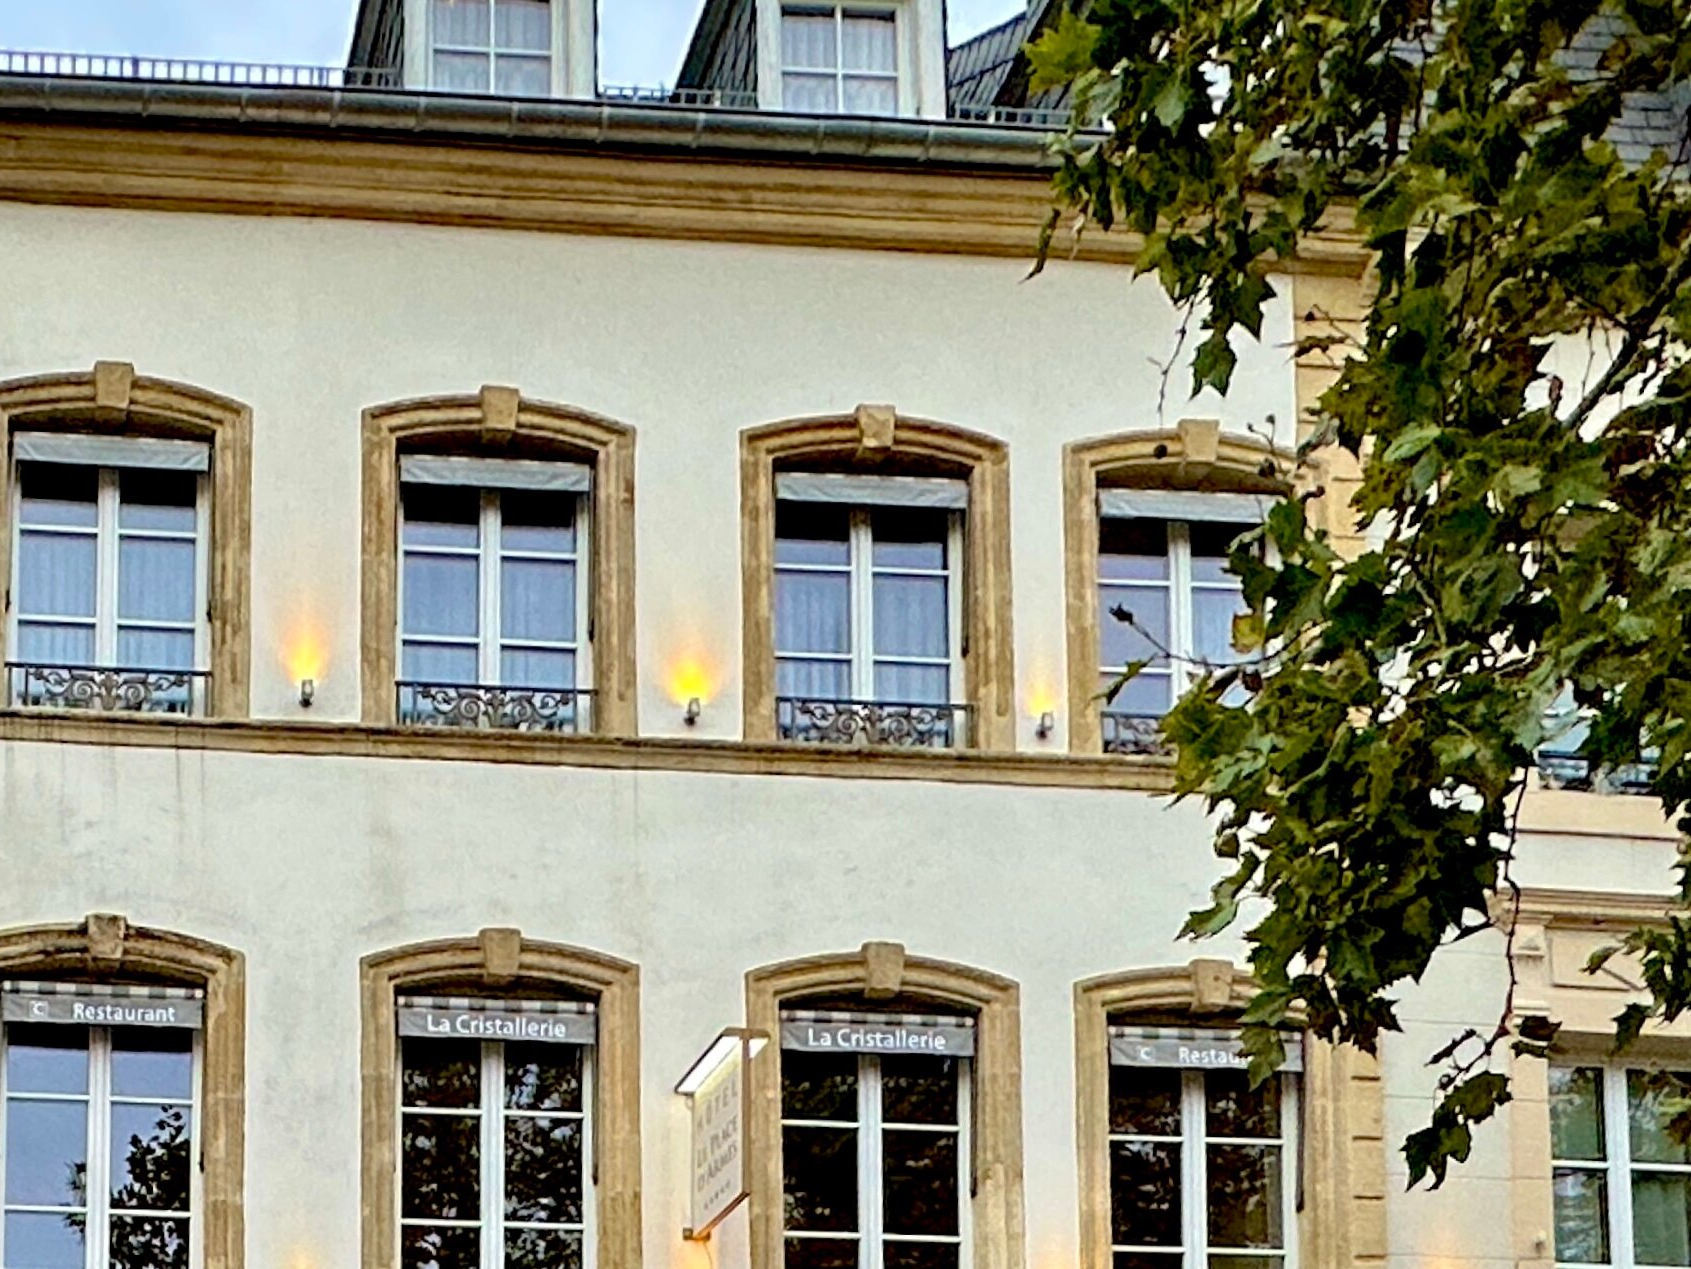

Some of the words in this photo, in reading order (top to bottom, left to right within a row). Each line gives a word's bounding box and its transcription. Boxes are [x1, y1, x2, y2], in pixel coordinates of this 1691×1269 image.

[73, 1002, 176, 1022] Restaurant
[427, 1014, 450, 1032] La
[456, 1015, 566, 1037] Cristallerie
[809, 1028, 832, 1046] La
[837, 1028, 946, 1050] Cristallerie
